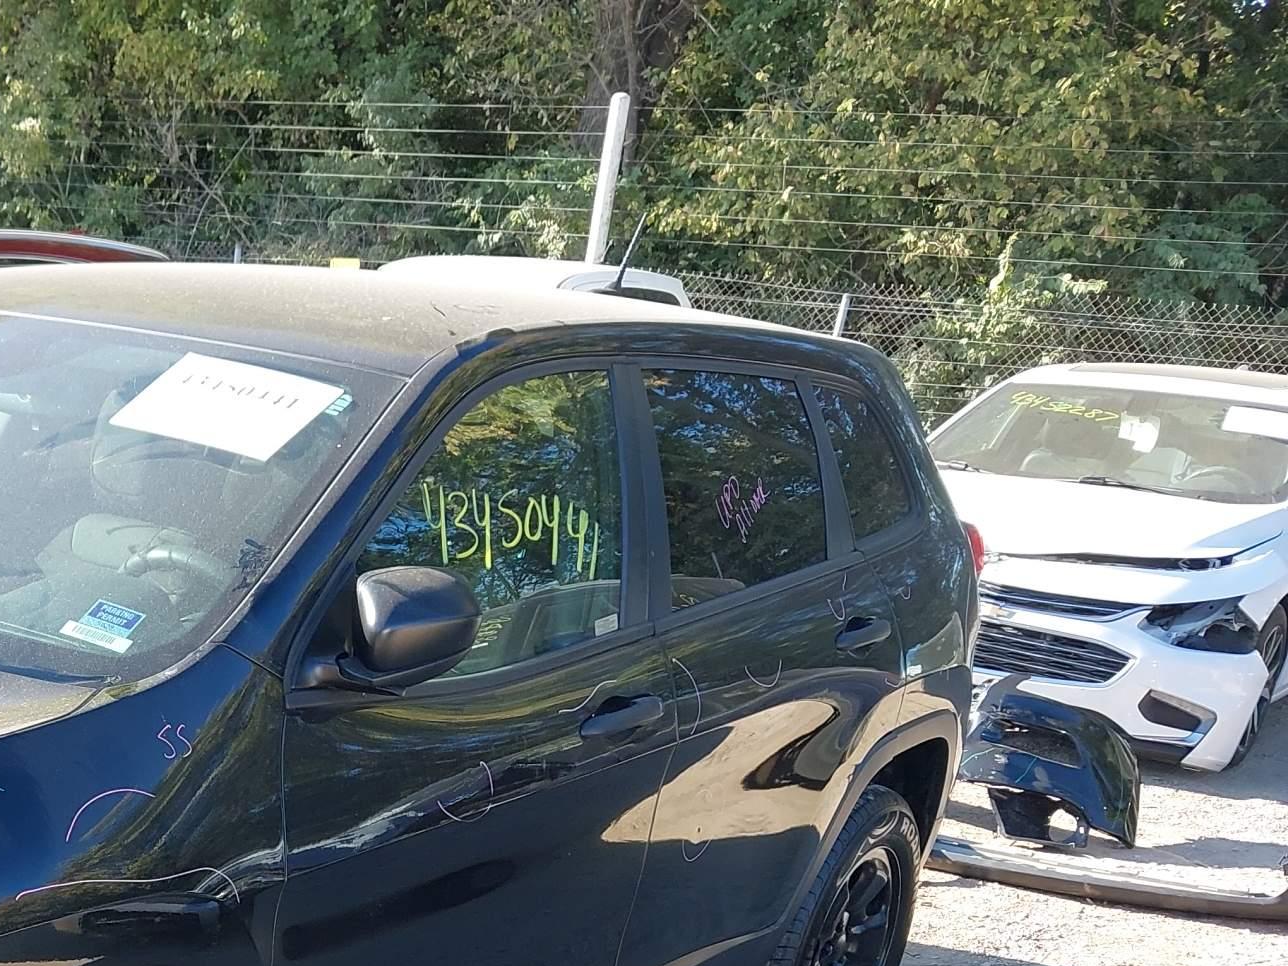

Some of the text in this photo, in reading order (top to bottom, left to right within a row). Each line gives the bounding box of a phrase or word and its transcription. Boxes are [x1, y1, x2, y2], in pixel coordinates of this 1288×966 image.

[421, 479, 599, 581] 43450441
[96, 611, 128, 626] PERMIT
[101, 604, 136, 620] PARKING
